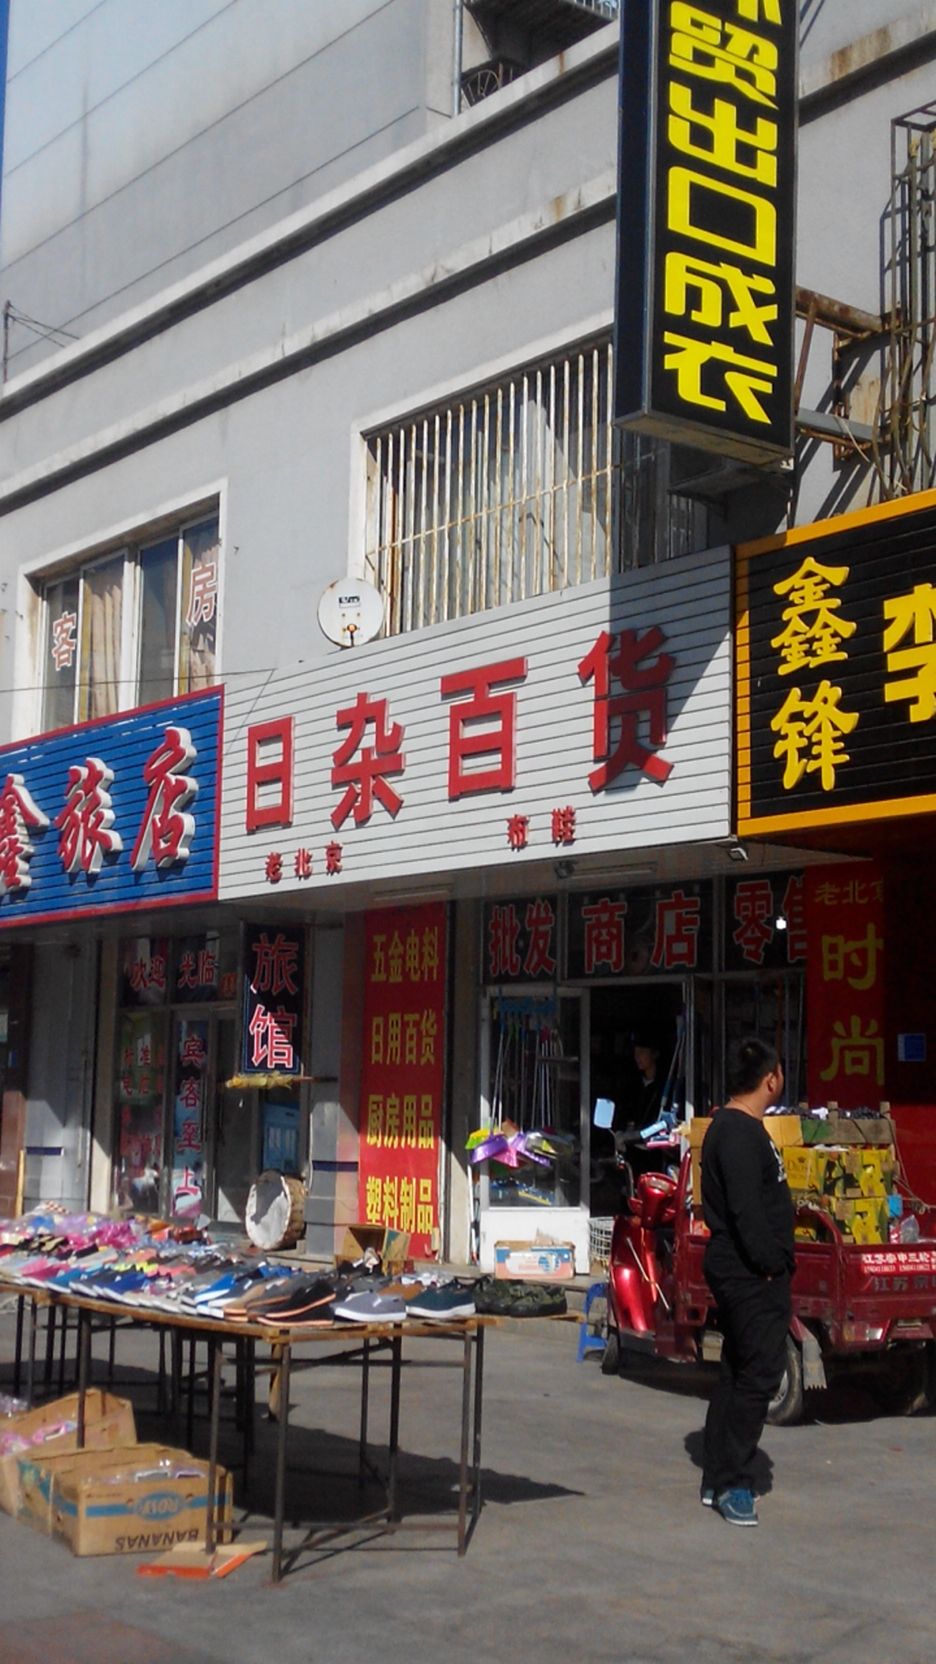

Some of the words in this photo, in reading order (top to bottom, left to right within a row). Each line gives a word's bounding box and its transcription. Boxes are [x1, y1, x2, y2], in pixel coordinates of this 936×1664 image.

[664, 0, 782, 424] 贸出口成衣
[52, 611, 77, 671] 客
[185, 561, 217, 626] 房
[770, 556, 859, 791] 鑫锋
[246, 625, 676, 834] 日杂百货
[264, 841, 343, 884] 老北京
[506, 805, 577, 852] 布鞋
[371, 926, 439, 983] 五金电料
[489, 901, 557, 977] 批发
[582, 890, 700, 975] 商店
[249, 933, 298, 1070] 旅馆
[371, 1009, 437, 1066] 日用百货
[820, 922, 885, 1086] 时尚
[176, 1034, 206, 1195] 宾客至上
[367, 1093, 435, 1150] 厨房用品
[366, 1175, 435, 1235] 塑料制品
[115, 1529, 199, 1550] BANANAS
